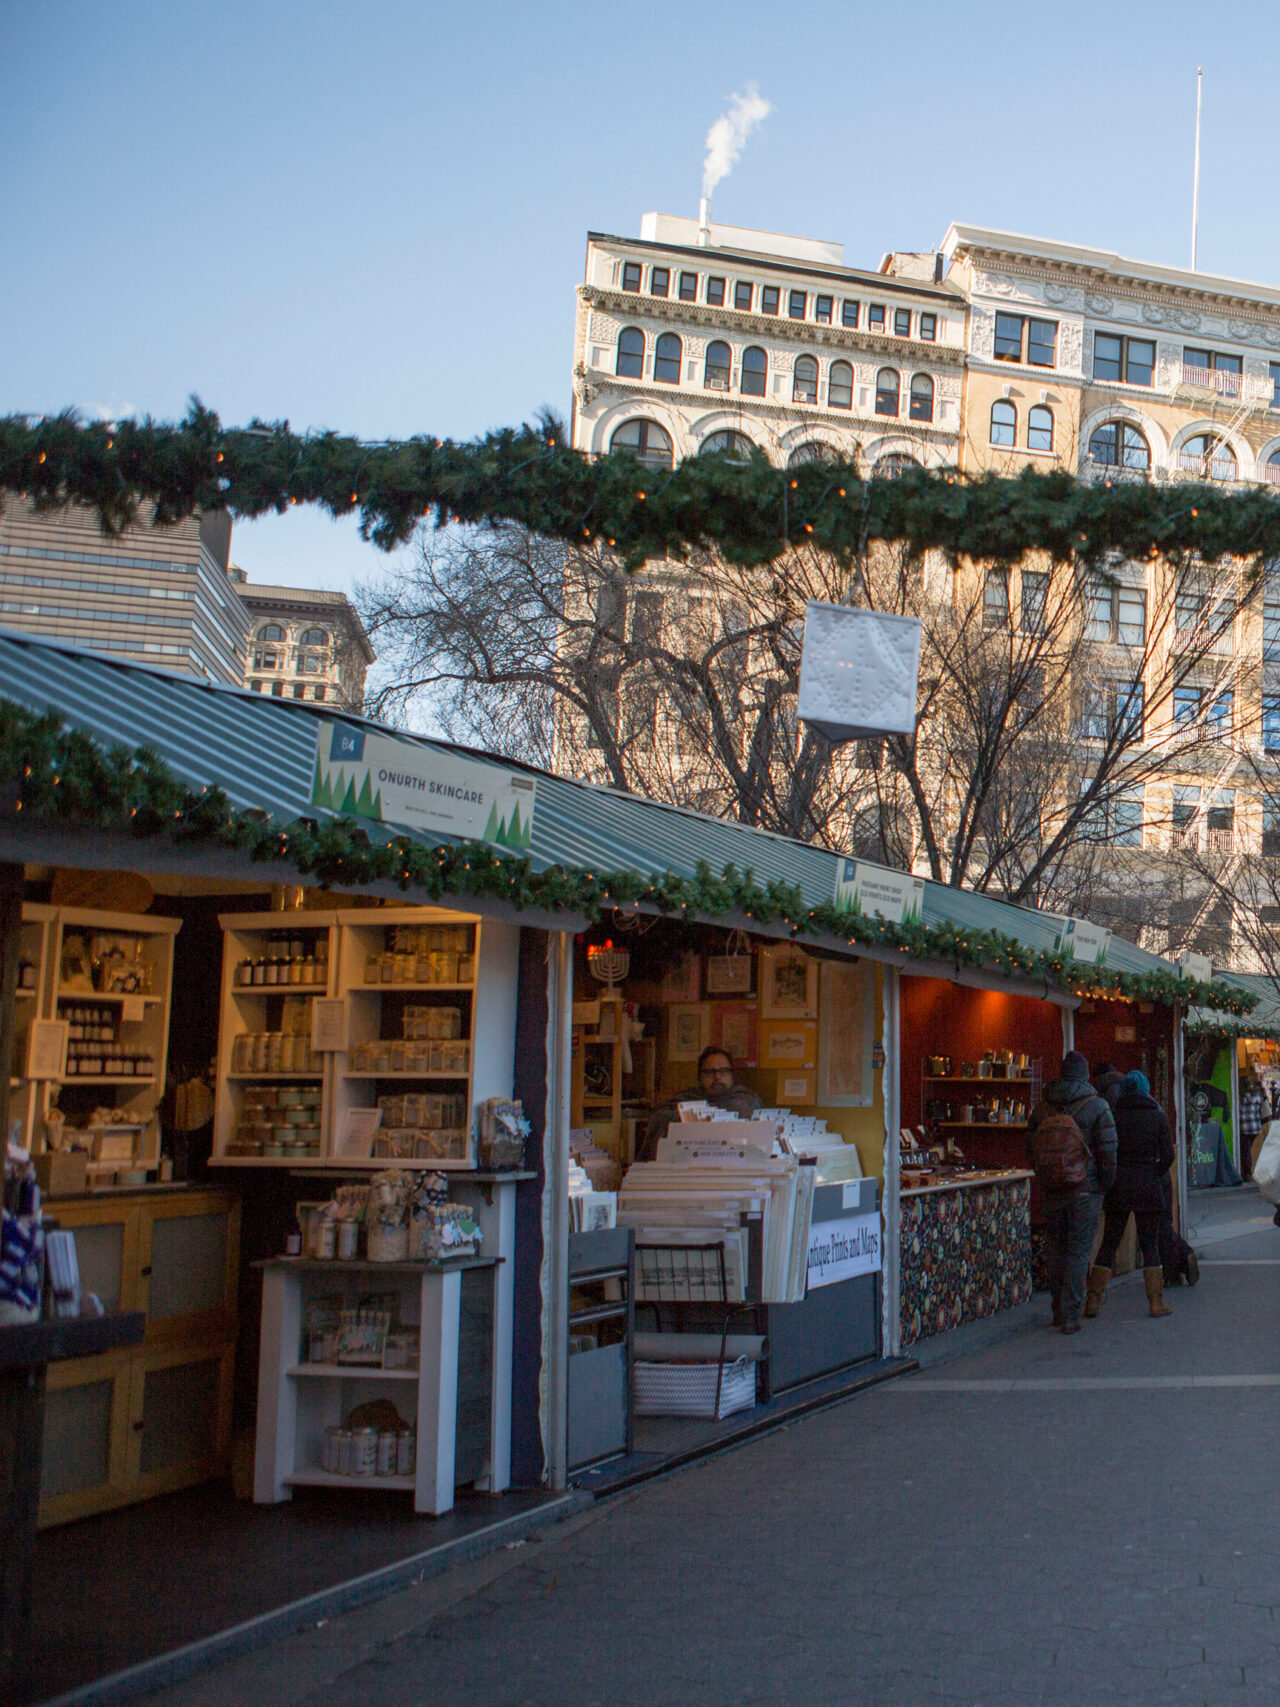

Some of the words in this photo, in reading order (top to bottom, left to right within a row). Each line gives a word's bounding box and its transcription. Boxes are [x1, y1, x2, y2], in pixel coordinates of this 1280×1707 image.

[378, 769, 426, 791] ONURTH
[429, 781, 484, 805] SKINCARE
[831, 1232, 848, 1263] Prints
[849, 1227, 861, 1259] and
[861, 1226, 878, 1264] Maps
